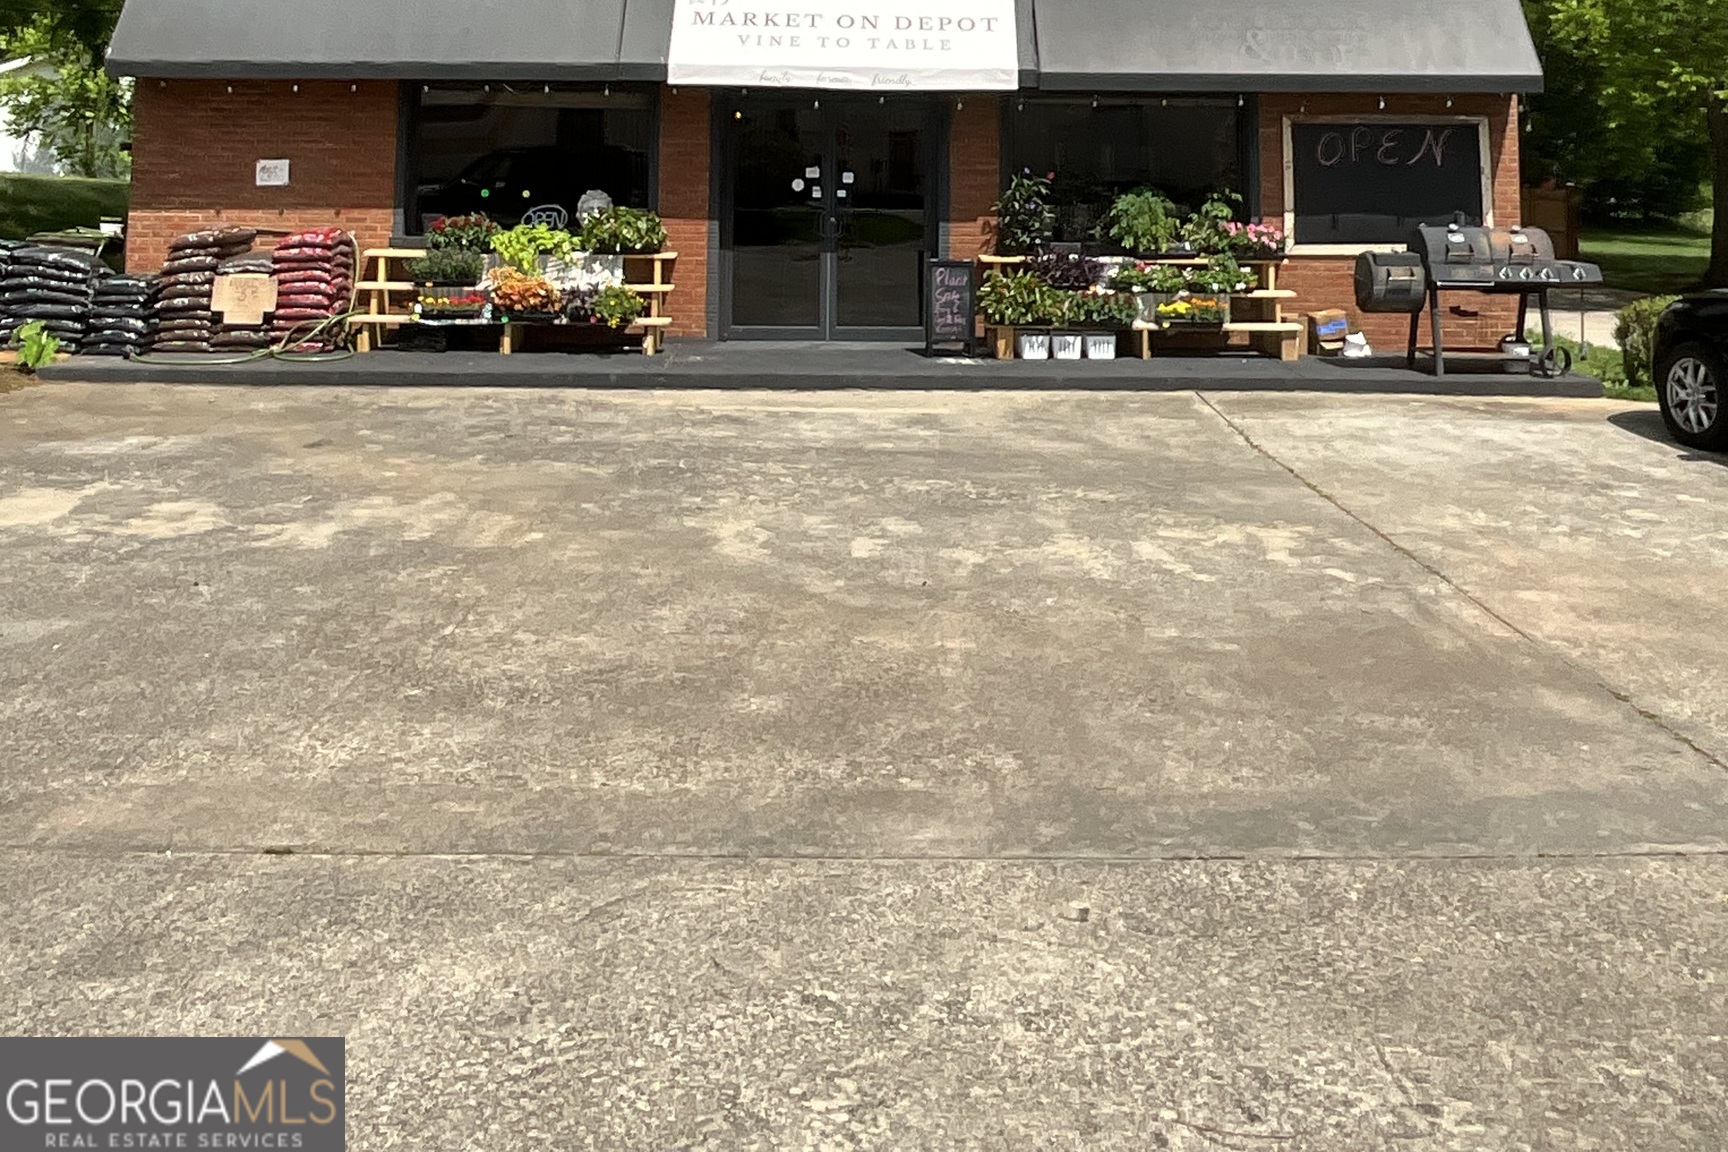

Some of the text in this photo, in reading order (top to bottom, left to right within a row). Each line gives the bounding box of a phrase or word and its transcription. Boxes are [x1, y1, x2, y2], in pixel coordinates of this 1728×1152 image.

[691, 11, 1000, 32] MARKET ON DEPOT
[737, 34, 952, 51] VINE TO TABLE
[1317, 126, 1455, 166] OPEN
[521, 210, 564, 229] OPEN
